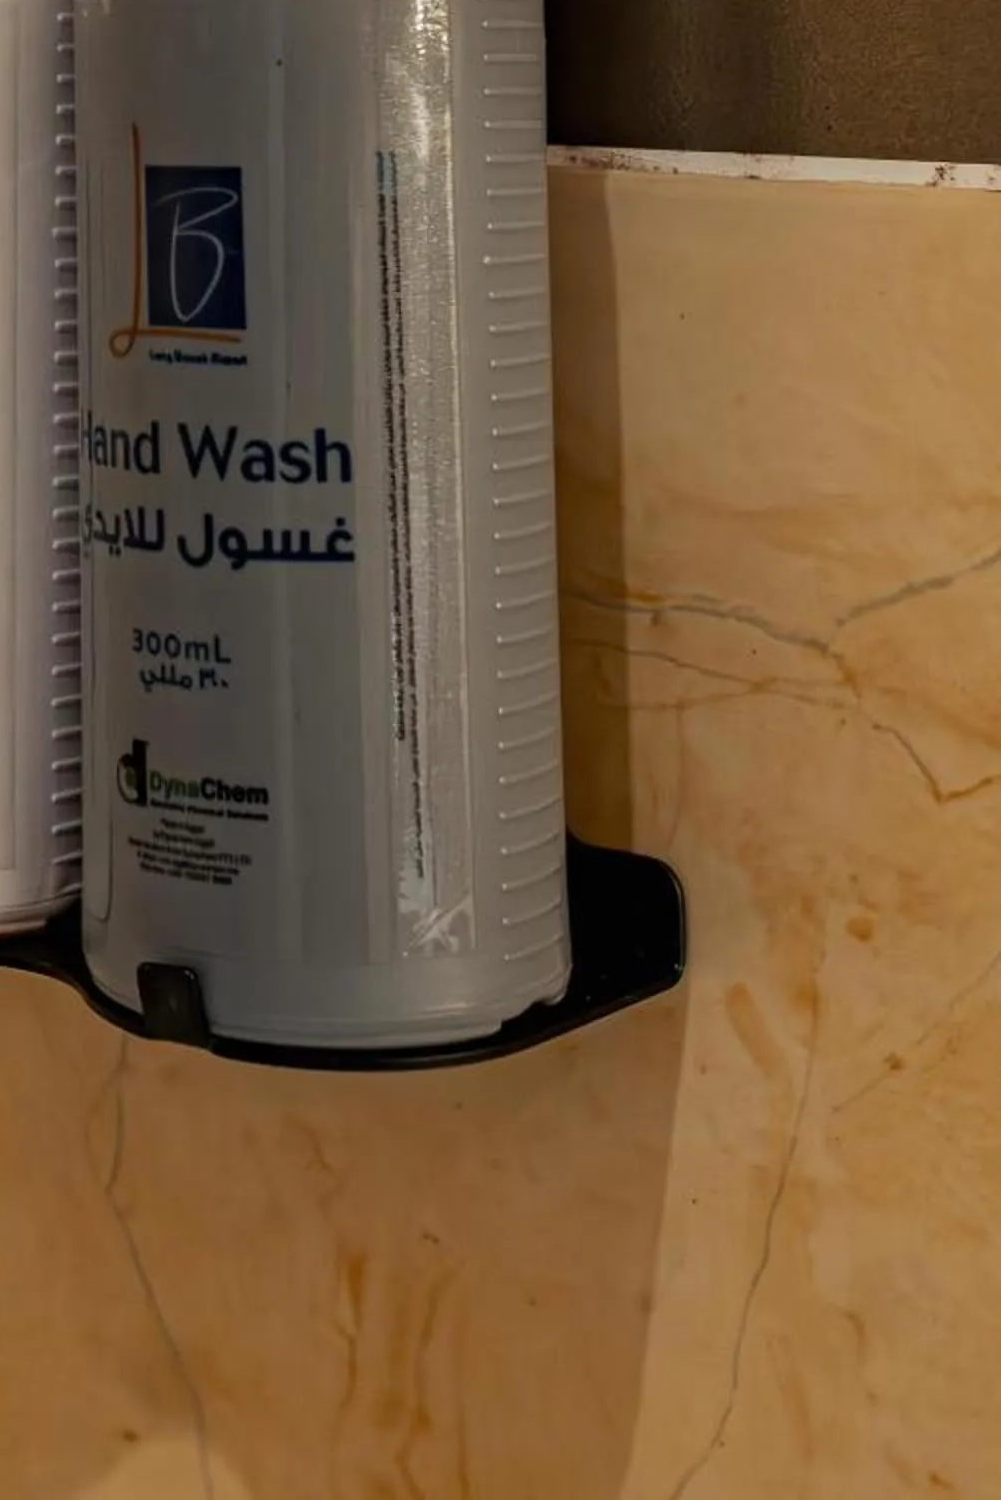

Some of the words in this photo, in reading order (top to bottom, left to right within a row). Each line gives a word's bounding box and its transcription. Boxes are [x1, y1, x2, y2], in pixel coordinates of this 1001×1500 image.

[177, 421, 352, 484] Wash
[177, 516, 356, 571] غسول
[132, 627, 232, 664] 300mL
[149, 769, 269, 805] DynaChem
